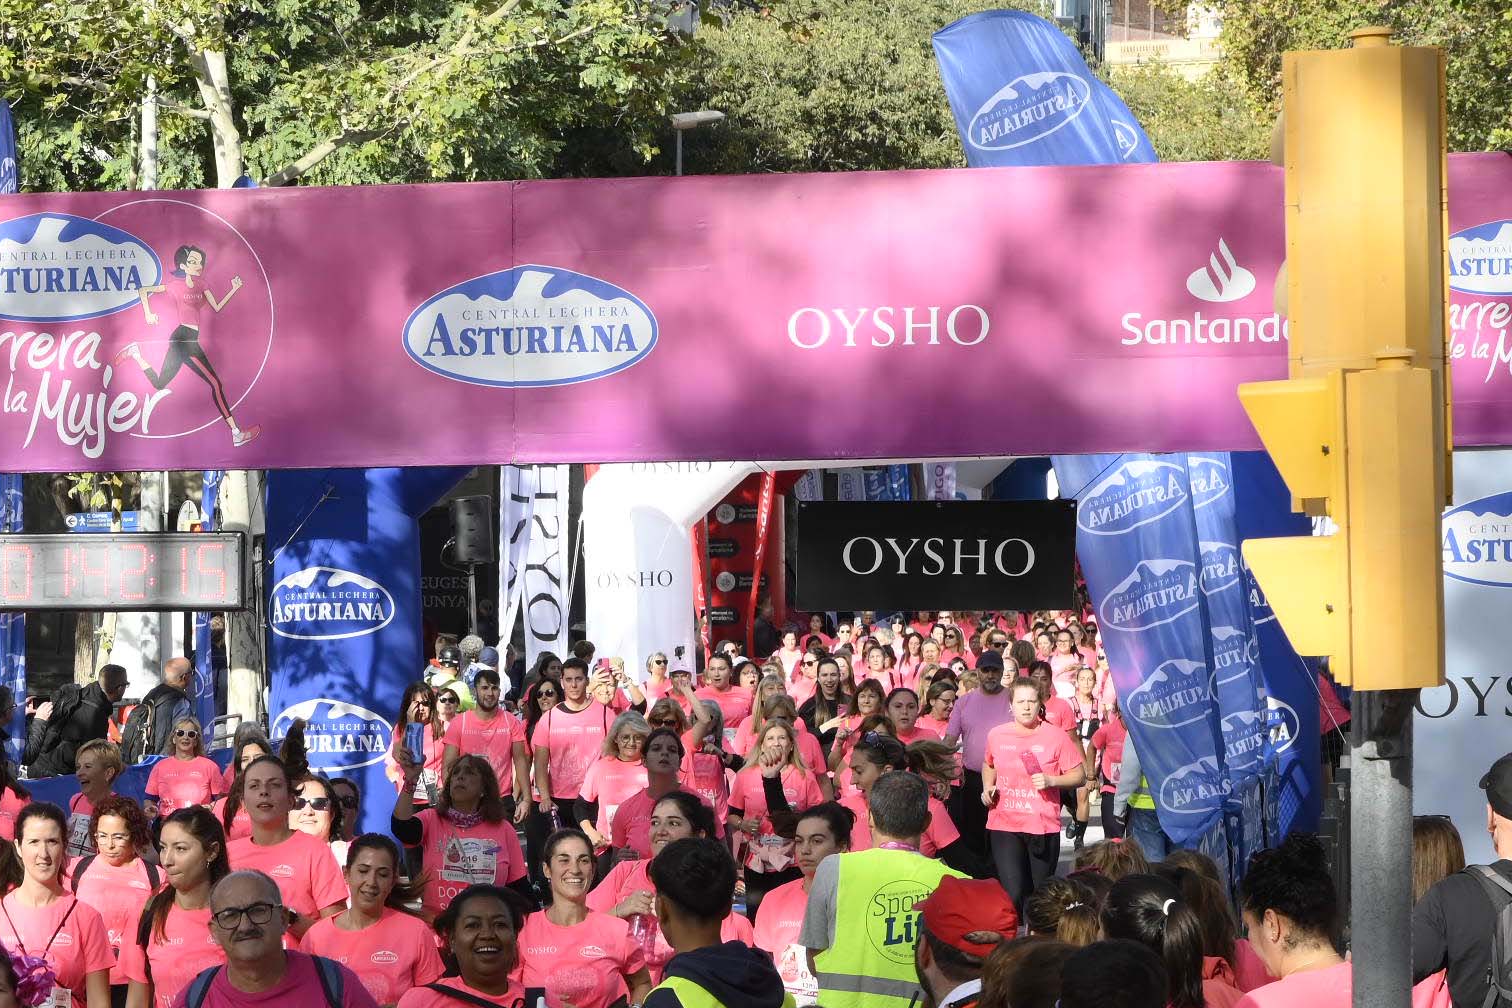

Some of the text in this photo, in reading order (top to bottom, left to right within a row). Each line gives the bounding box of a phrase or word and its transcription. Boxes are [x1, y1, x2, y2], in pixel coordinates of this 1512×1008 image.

[65, 248, 137, 261] LECHERA
[462, 307, 630, 320] CENTRAL LECHERA
[787, 305, 989, 349] OYSHO
[1121, 312, 1288, 345] Santand
[423, 313, 638, 358] ASTURIANA
[4, 370, 28, 414] la
[24, 363, 174, 459] Mujer
[525, 466, 562, 642] OYSH
[842, 536, 1036, 578] OYSHO
[596, 570, 674, 588] OYSHO
[273, 596, 385, 624] ASTURIANA
[285, 591, 381, 600] CENTRAL LECHERA
[332, 723, 382, 731] LECHERA
[304, 734, 386, 753] URIANA
[884, 913, 924, 950] Lif
